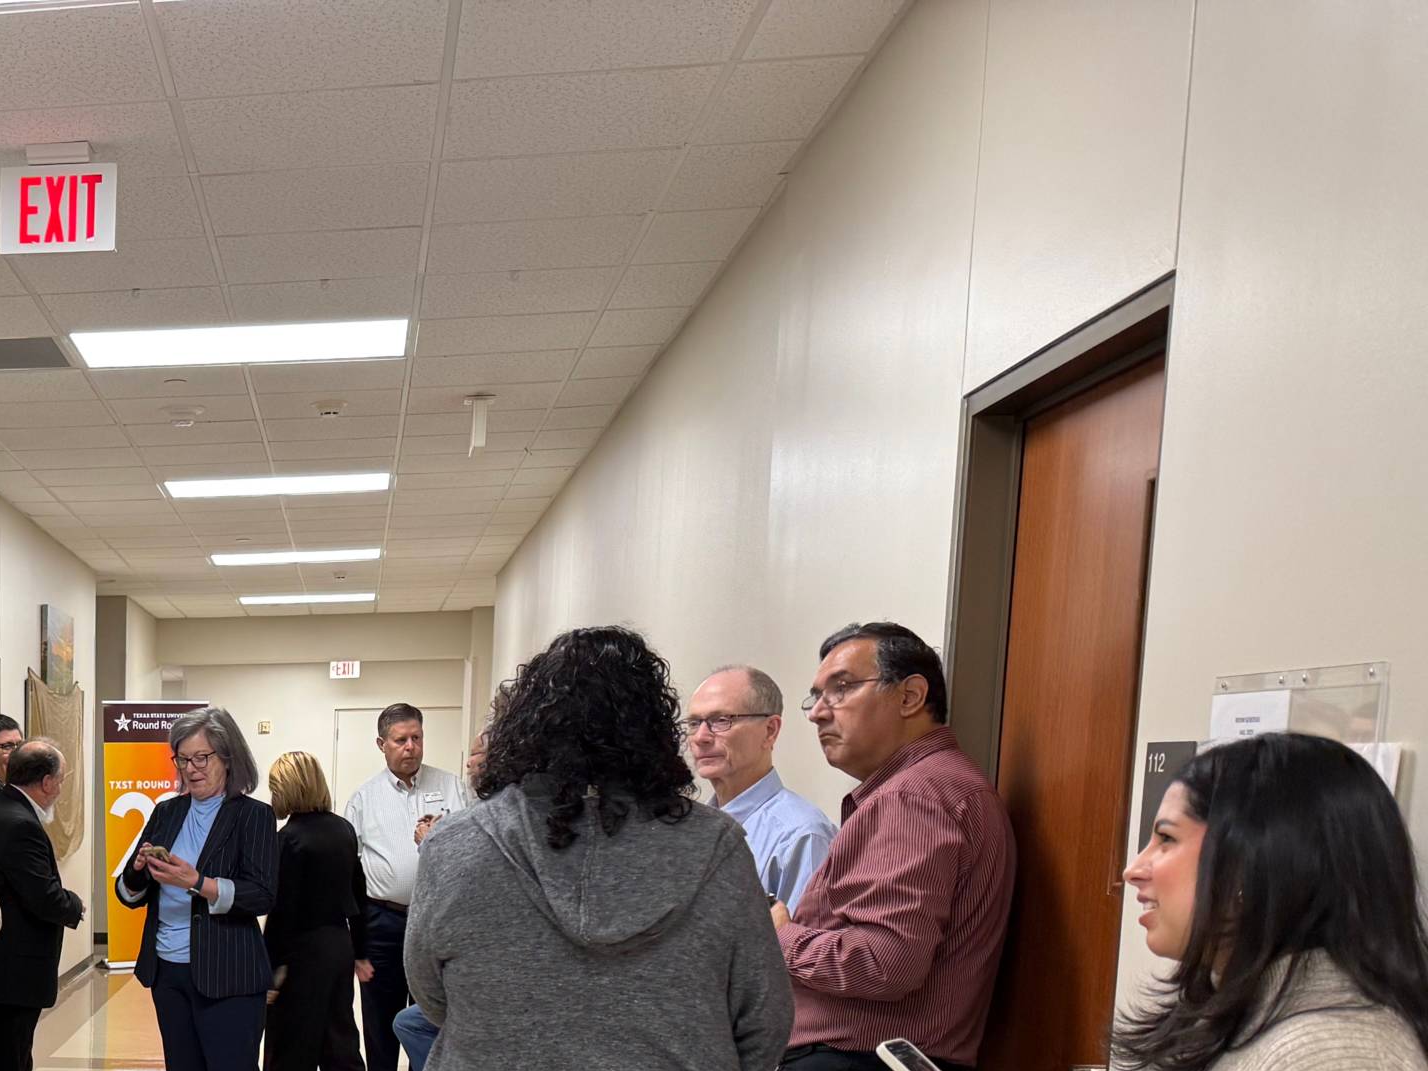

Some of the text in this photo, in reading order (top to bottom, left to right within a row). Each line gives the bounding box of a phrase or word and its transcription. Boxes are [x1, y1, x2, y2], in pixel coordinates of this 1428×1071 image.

[19, 175, 103, 244] EXIT
[336, 663, 356, 676] EXIT
[133, 721, 160, 730] Round
[1149, 753, 1165, 773] 112
[109, 780, 134, 790] TXST
[136, 780, 171, 790] ROUND
